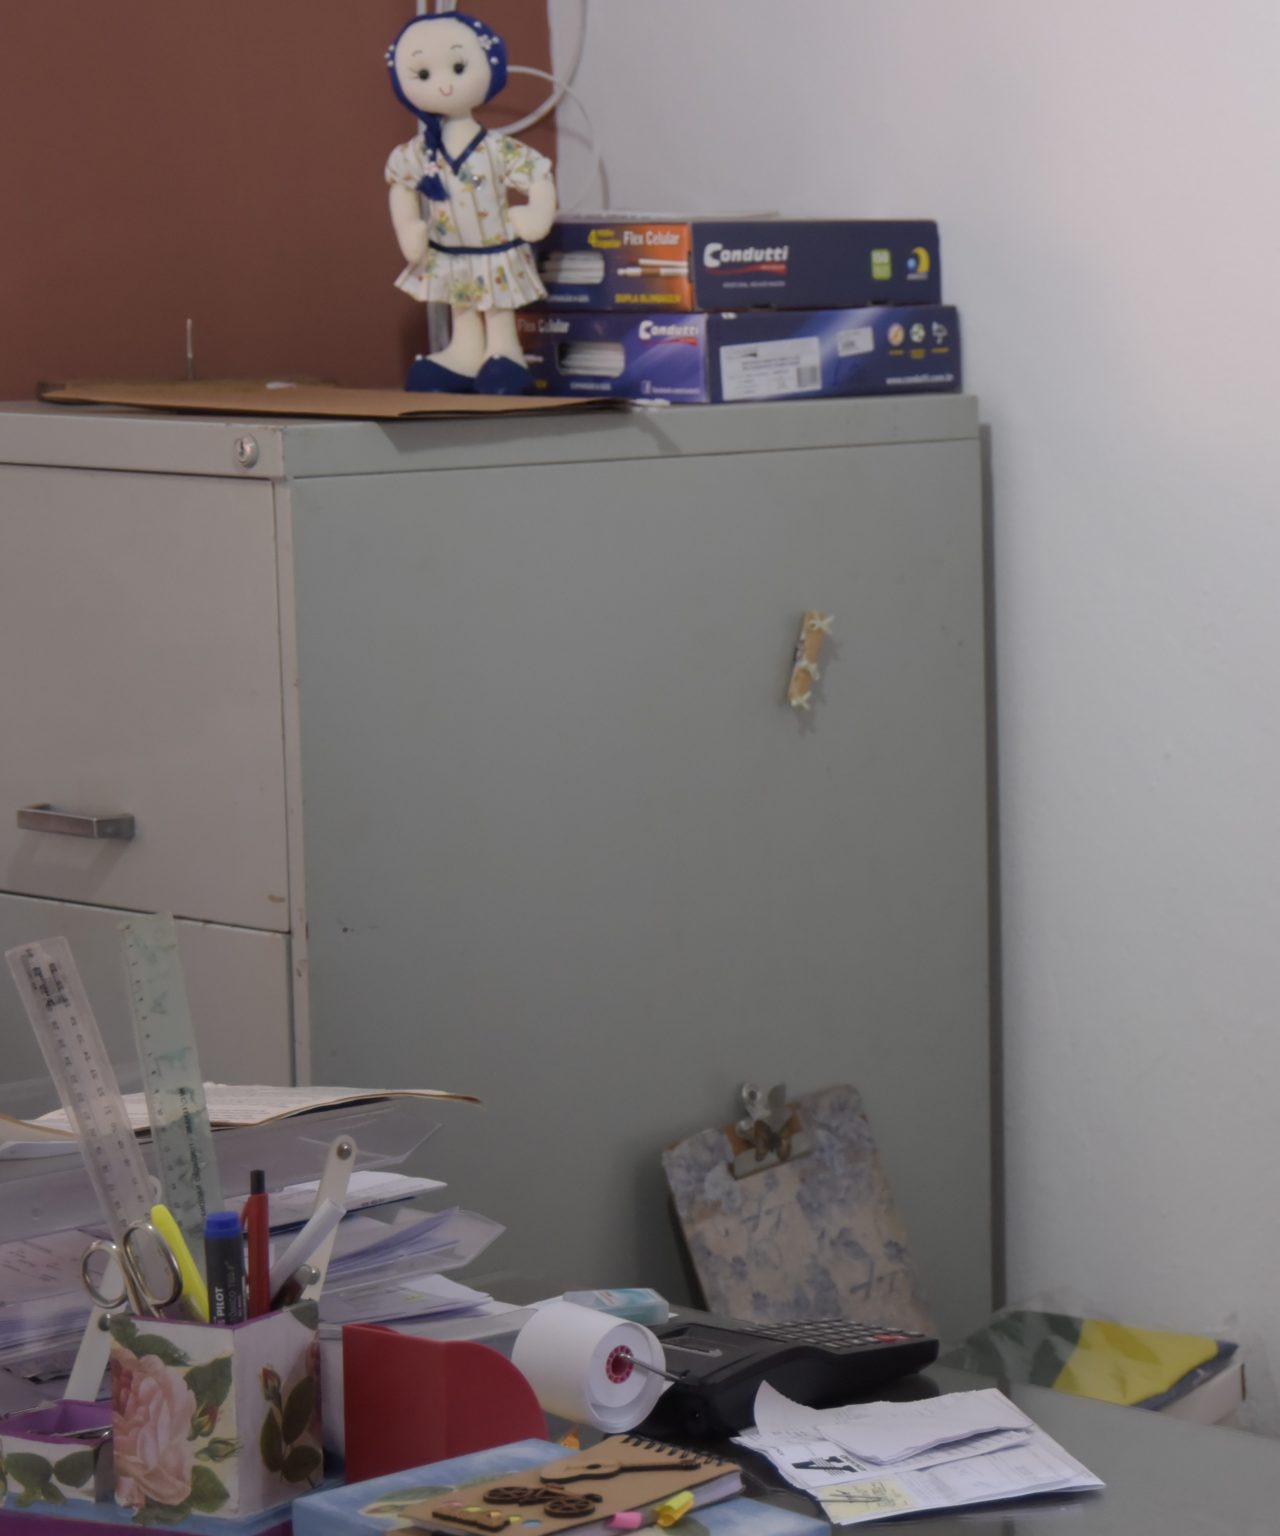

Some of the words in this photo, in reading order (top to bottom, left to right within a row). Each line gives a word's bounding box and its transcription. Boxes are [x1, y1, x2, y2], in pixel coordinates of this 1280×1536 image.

[623, 230, 644, 246] Flex
[646, 230, 680, 246] Celular
[703, 242, 789, 268] Condutti
[638, 319, 700, 341] Condutti
[214, 1286, 225, 1317] PILOT
